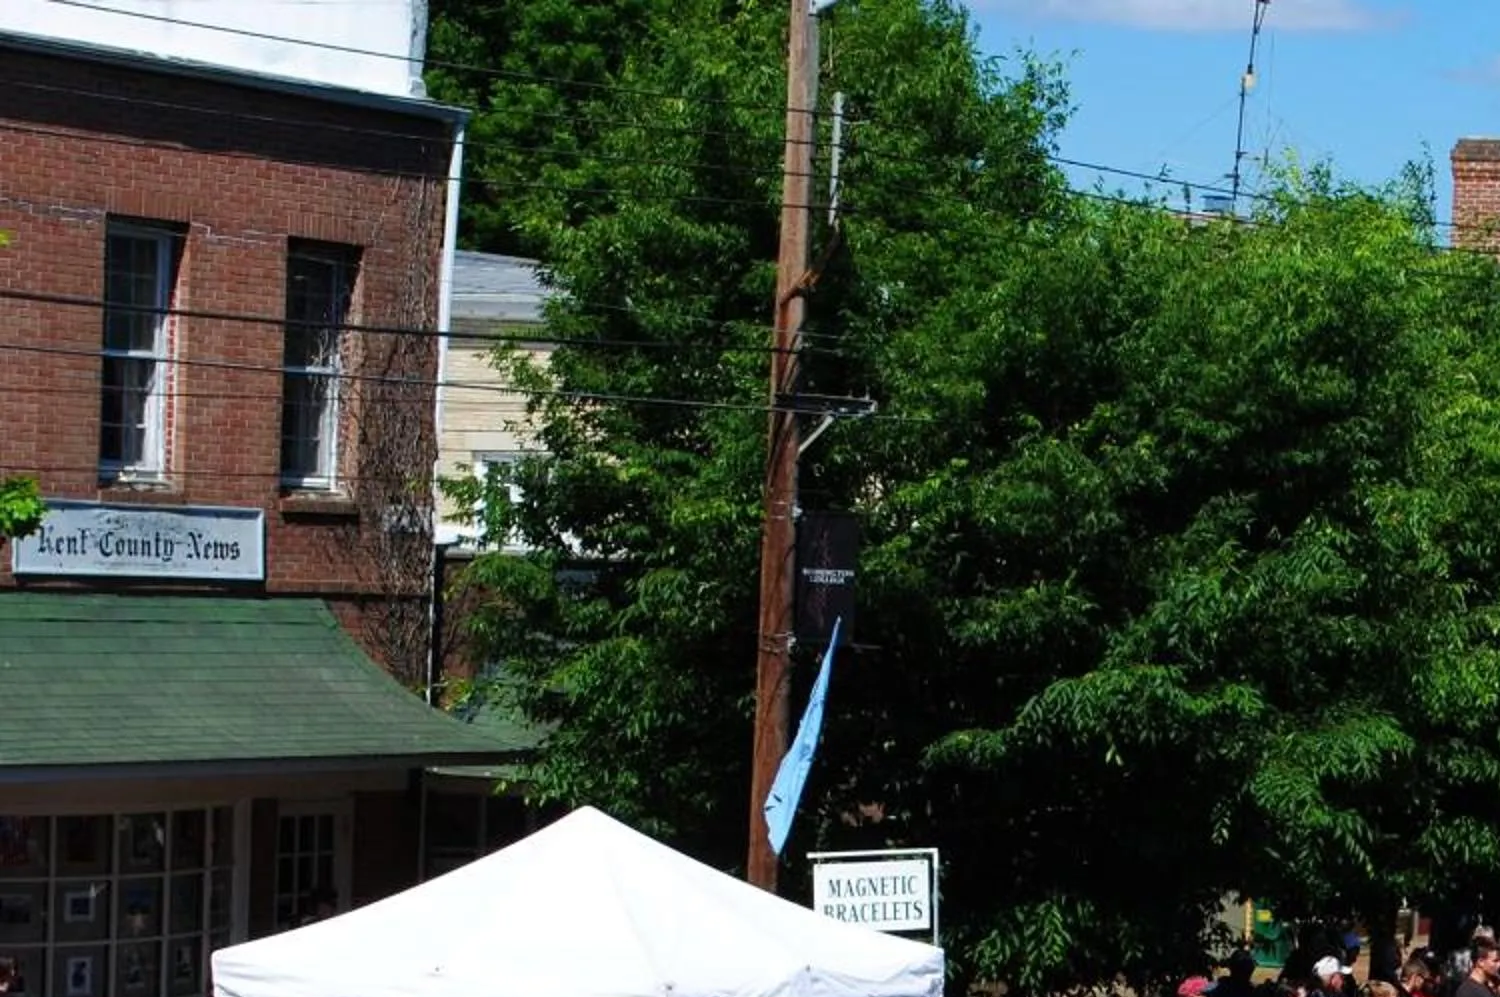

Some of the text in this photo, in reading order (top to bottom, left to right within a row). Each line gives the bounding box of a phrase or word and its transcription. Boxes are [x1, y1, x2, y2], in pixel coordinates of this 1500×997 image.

[38, 526, 241, 562] Kent County News
[827, 875, 919, 898] MAGNETIC
